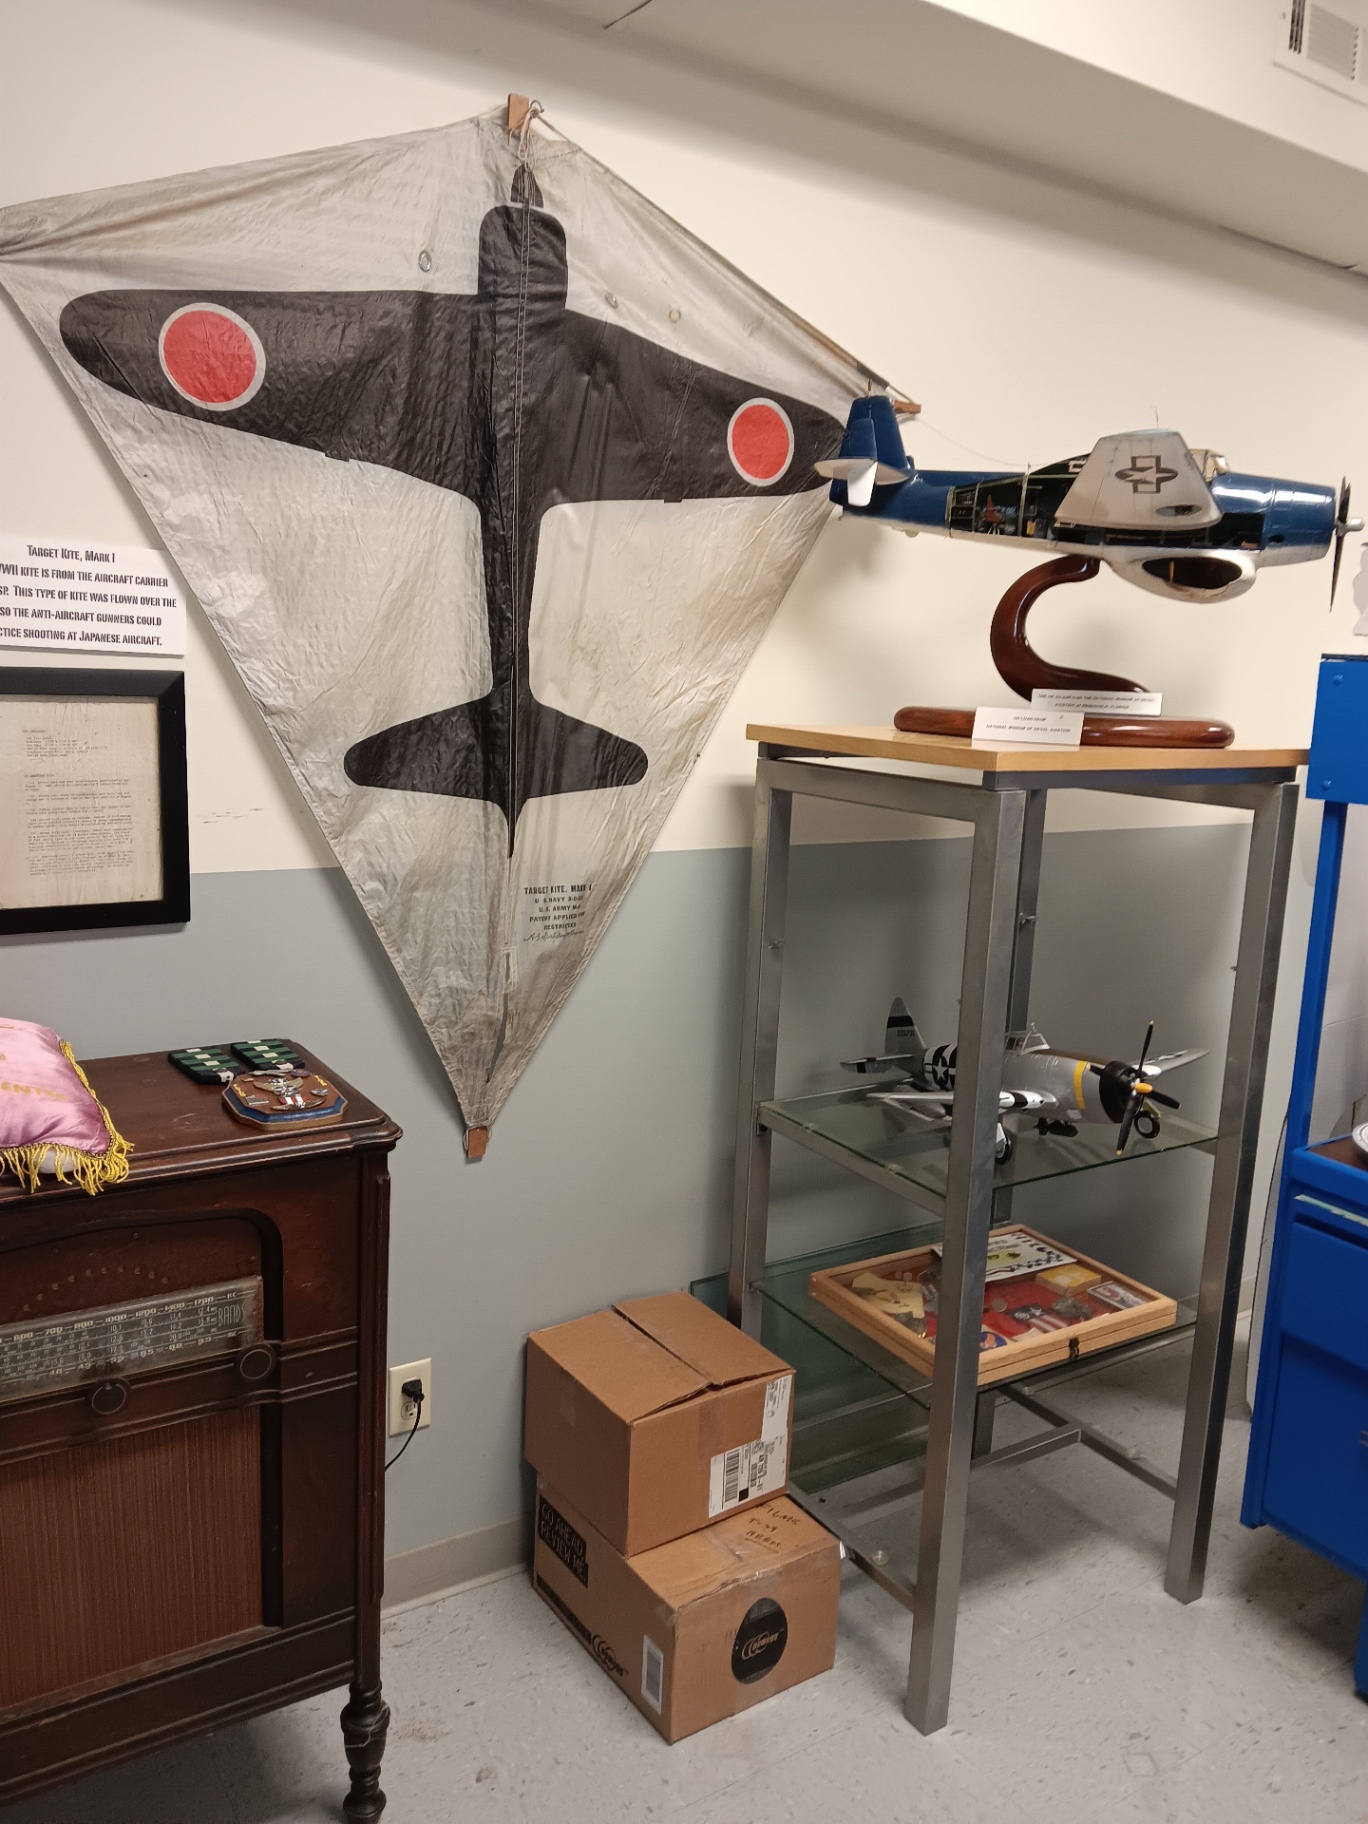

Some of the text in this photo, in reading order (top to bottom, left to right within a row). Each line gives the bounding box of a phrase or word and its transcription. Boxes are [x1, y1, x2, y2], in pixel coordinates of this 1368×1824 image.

[26, 545, 59, 558] TARGET
[61, 548, 82, 562] KITE,
[85, 550, 110, 563] MARK
[20, 566, 39, 577] KITE
[41, 568, 50, 578] IS
[51, 569, 75, 580] FROM
[77, 571, 93, 582] THE
[94, 573, 133, 585] AIRCRAFT
[135, 576, 168, 587] CARRIER
[13, 585, 33, 597] THIS
[35, 588, 56, 599] TYPE
[57, 590, 68, 600] OF
[70, 591, 88, 601] KITE
[89, 592, 109, 603] WAS
[110, 594, 138, 605] FLOWN
[140, 596, 160, 606] OVER
[162, 598, 177, 608] THE
[13, 607, 29, 618] THE
[31, 608, 94, 622] ANTI-AIRCRAFT
[97, 613, 135, 624] GUNNERS
[136, 616, 162, 626] COULD
[23, 628, 65, 640] SHOOTING
[67, 631, 77, 641] AT
[79, 630, 121, 644] JAPANESE
[122, 634, 162, 646] AIRCRAFT.
